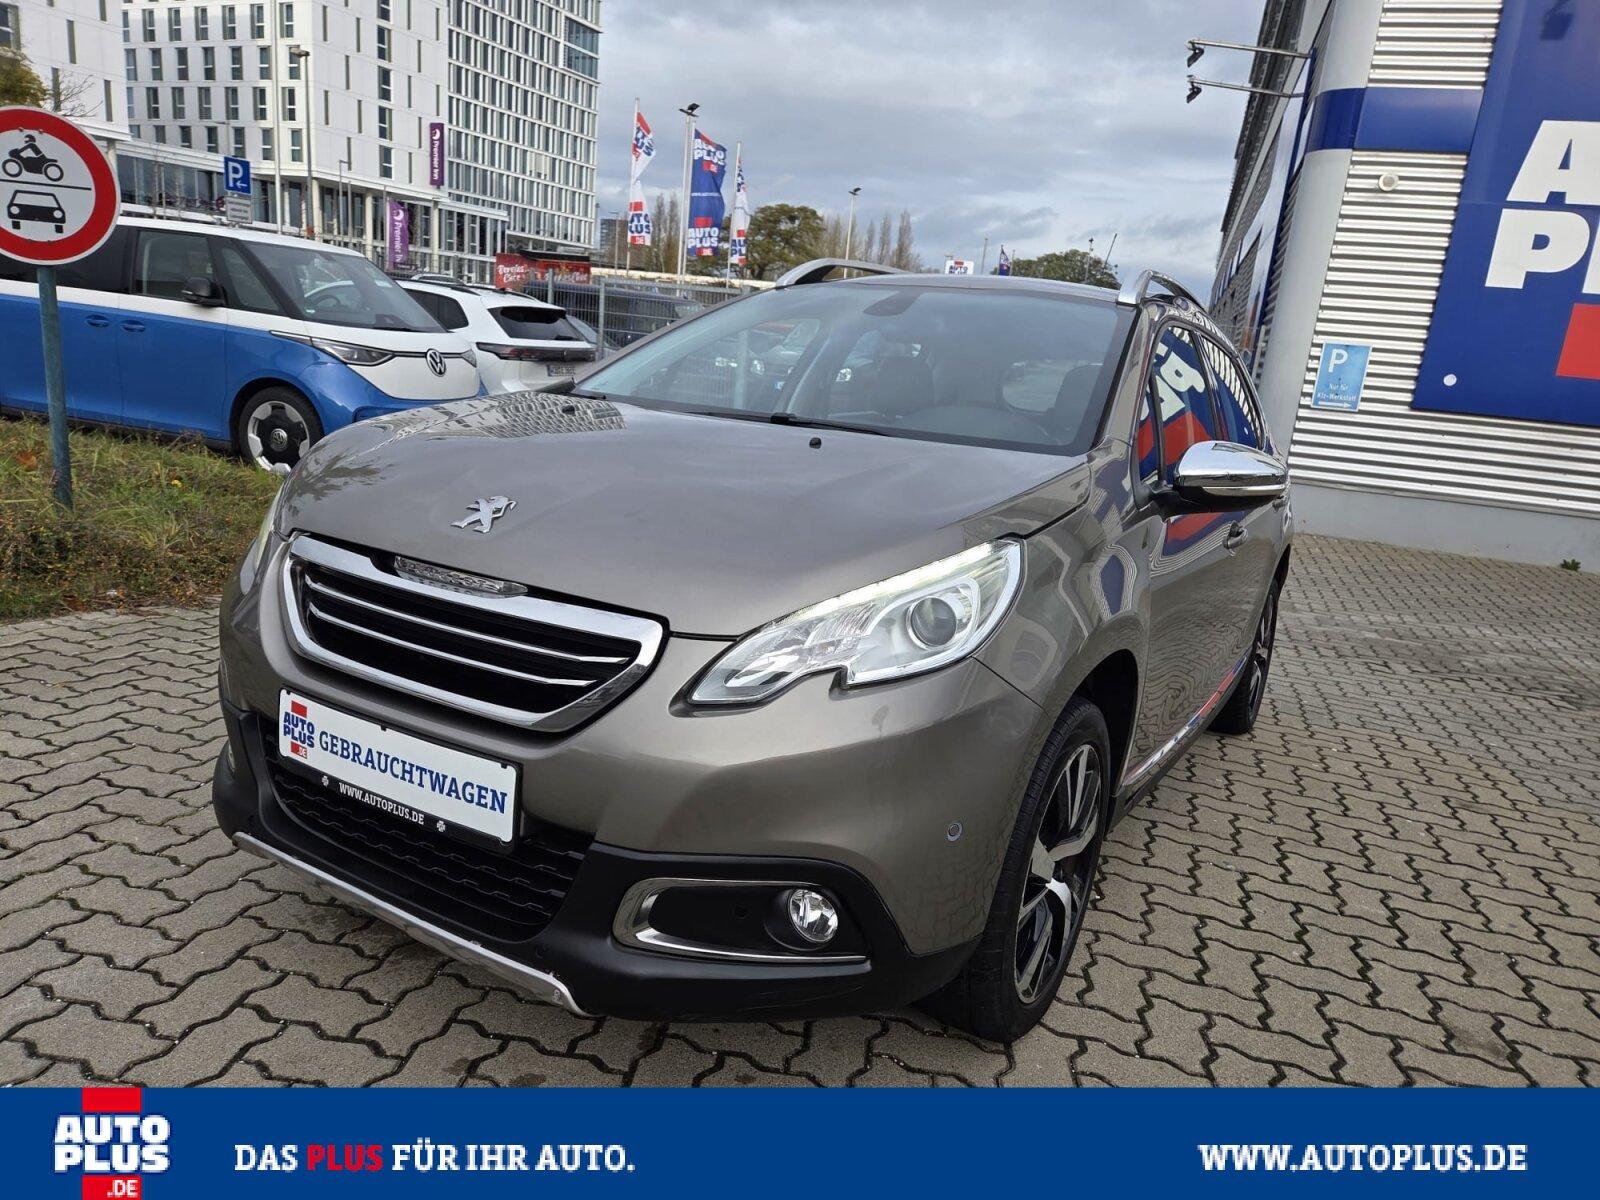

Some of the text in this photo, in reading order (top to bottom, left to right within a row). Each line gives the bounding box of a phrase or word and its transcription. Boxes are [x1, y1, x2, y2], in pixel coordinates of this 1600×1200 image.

[432, 140, 440, 180] Premier Inn
[228, 162, 243, 188] P
[393, 221, 403, 252] Premier
[687, 237, 718, 249] PLUS
[688, 227, 719, 238] AUTO
[1328, 348, 1348, 373] P
[283, 711, 315, 735] AUTO
[283, 724, 315, 748] PLUS
[319, 731, 508, 815] GEBRAUCHTWAGEN
[338, 782, 425, 826] WWW.AUTOPLUS.DE
